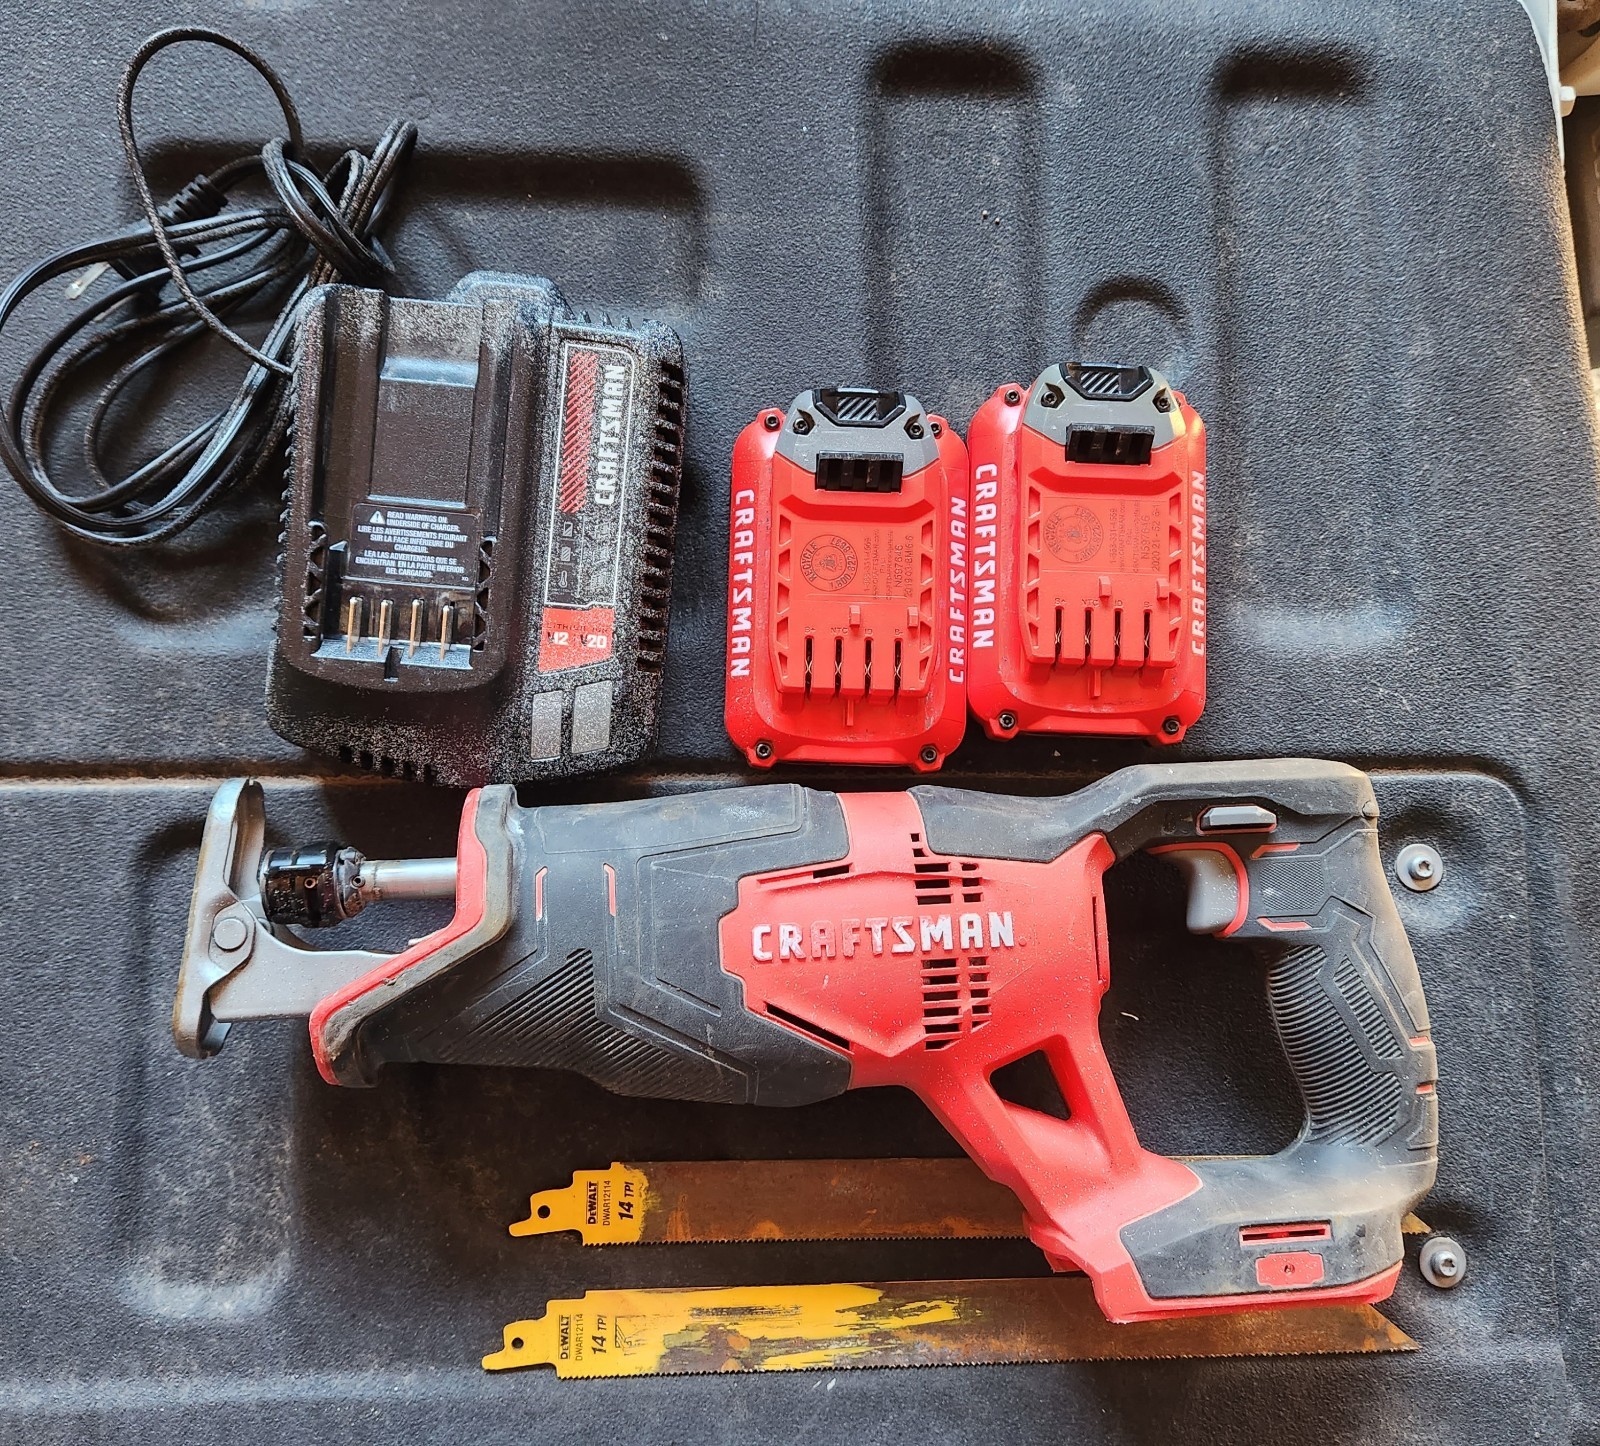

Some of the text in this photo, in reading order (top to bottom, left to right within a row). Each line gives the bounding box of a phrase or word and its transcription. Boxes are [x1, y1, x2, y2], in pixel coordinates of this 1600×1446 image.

[595, 364, 625, 505] CRAFTSMAN
[358, 525, 468, 542] LIRE LES AVERTISSEMENTS FIGURANT
[387, 511, 404, 519] READ
[405, 512, 437, 522] WARNINGS
[387, 518, 420, 529] UNDERSIDE
[422, 521, 430, 529] OF
[386, 567, 398, 575] DEL
[390, 552, 435, 564] ADVERTENCIAS
[398, 560, 406, 568] EN
[406, 561, 416, 569] LA
[416, 562, 436, 571] PARTE
[436, 564, 464, 574] INFERIOR
[800, 540, 818, 583] RECYCLE
[973, 463, 998, 648] CRAFTSMAN
[1191, 470, 1205, 656] CRAFTSMAN
[731, 489, 755, 677] CRAFTSMAN
[949, 497, 967, 684] CRAFTSMAN
[751, 910, 1015, 963] CRAFTSMAN
[602, 1180, 611, 1226] DWAR12114
[618, 1181, 634, 1221] 14 TPI
[575, 1313, 584, 1361] DWAR12114
[591, 1314, 608, 1355] 14 TPI
